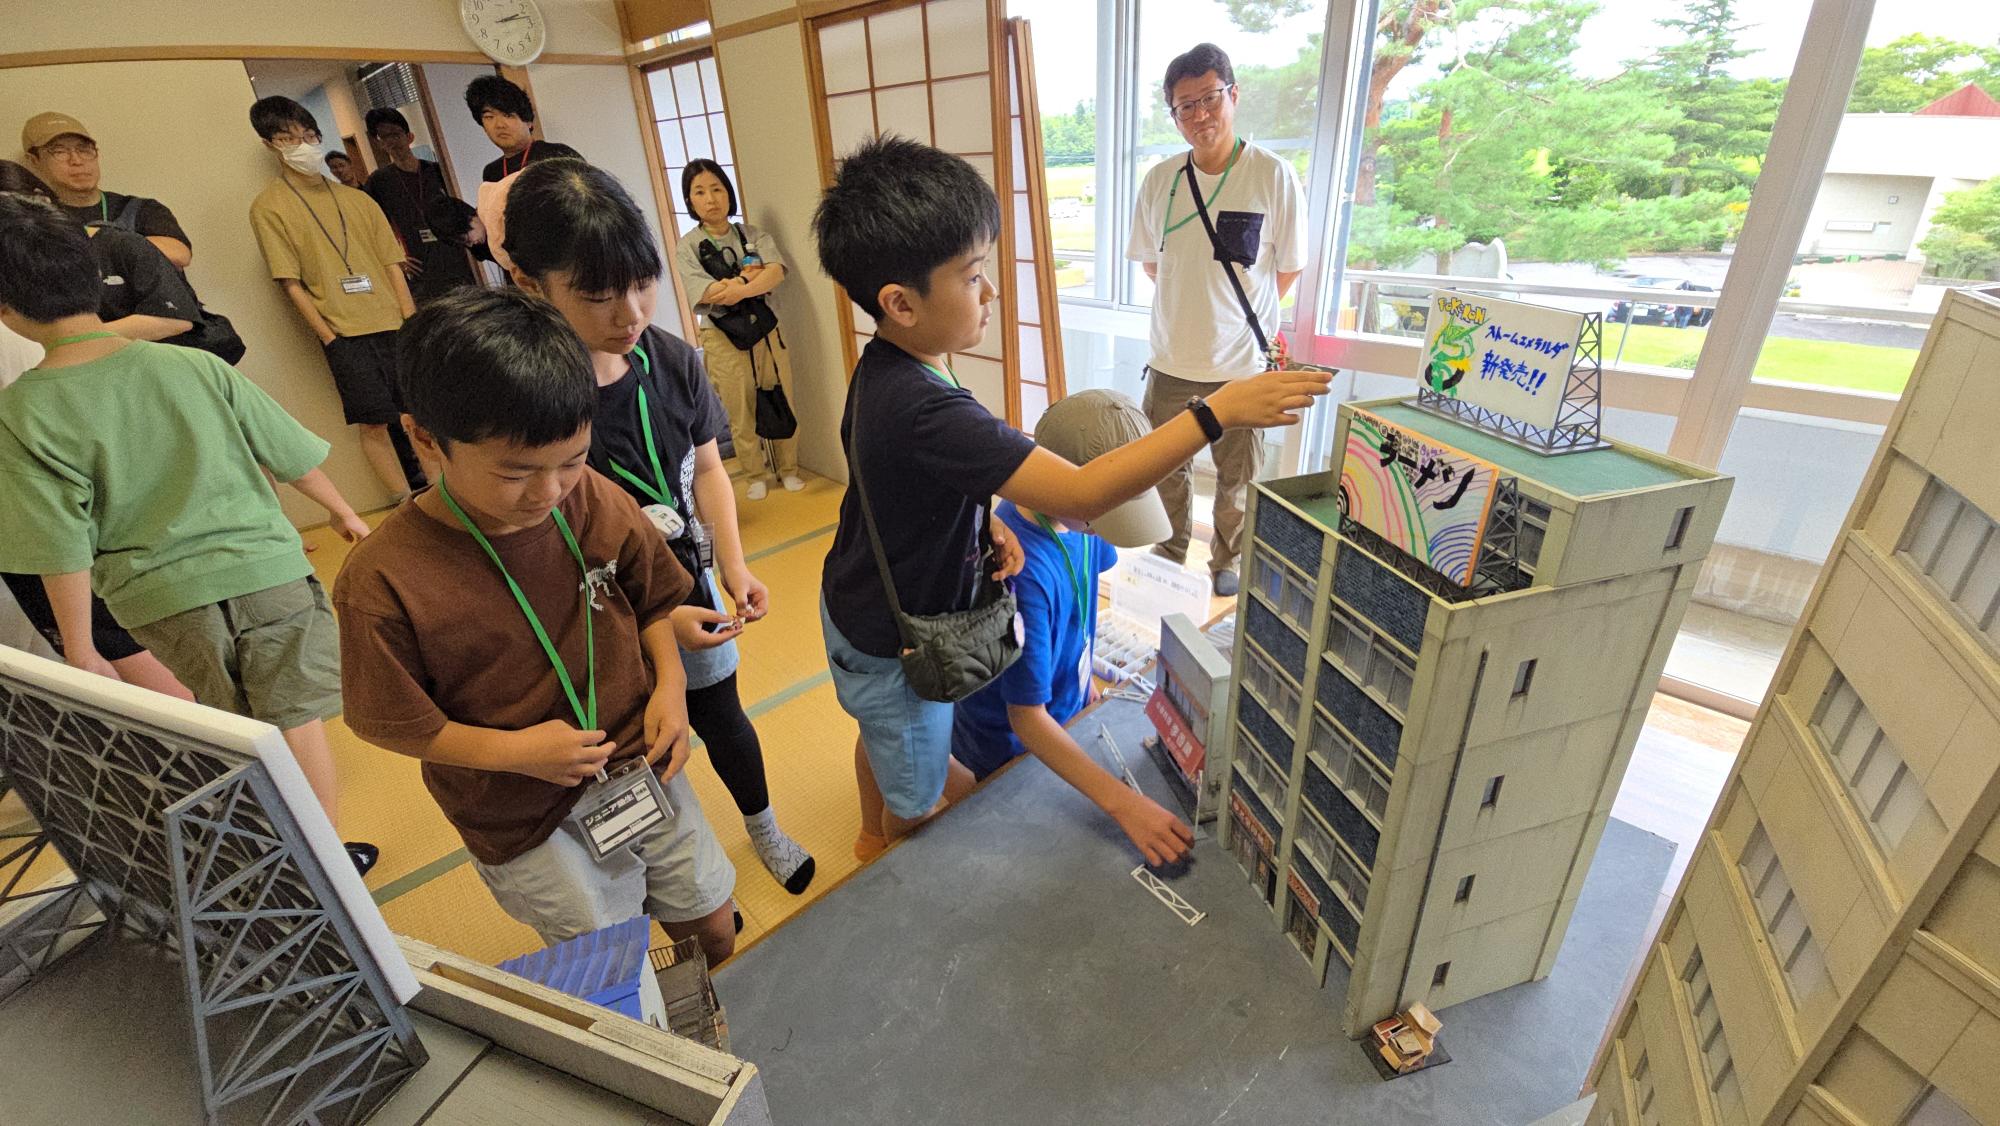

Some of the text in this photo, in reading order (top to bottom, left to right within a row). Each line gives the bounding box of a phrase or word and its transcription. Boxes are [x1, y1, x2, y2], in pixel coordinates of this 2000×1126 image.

[473, 0, 484, 11] 10
[519, 3, 527, 14] 2
[471, 13, 480, 24] 9
[527, 17, 535, 29] 3
[480, 28, 488, 39] 8
[524, 31, 532, 42] 4
[493, 39, 500, 49] 7
[506, 44, 514, 53] 6
[518, 40, 525, 51] 5
